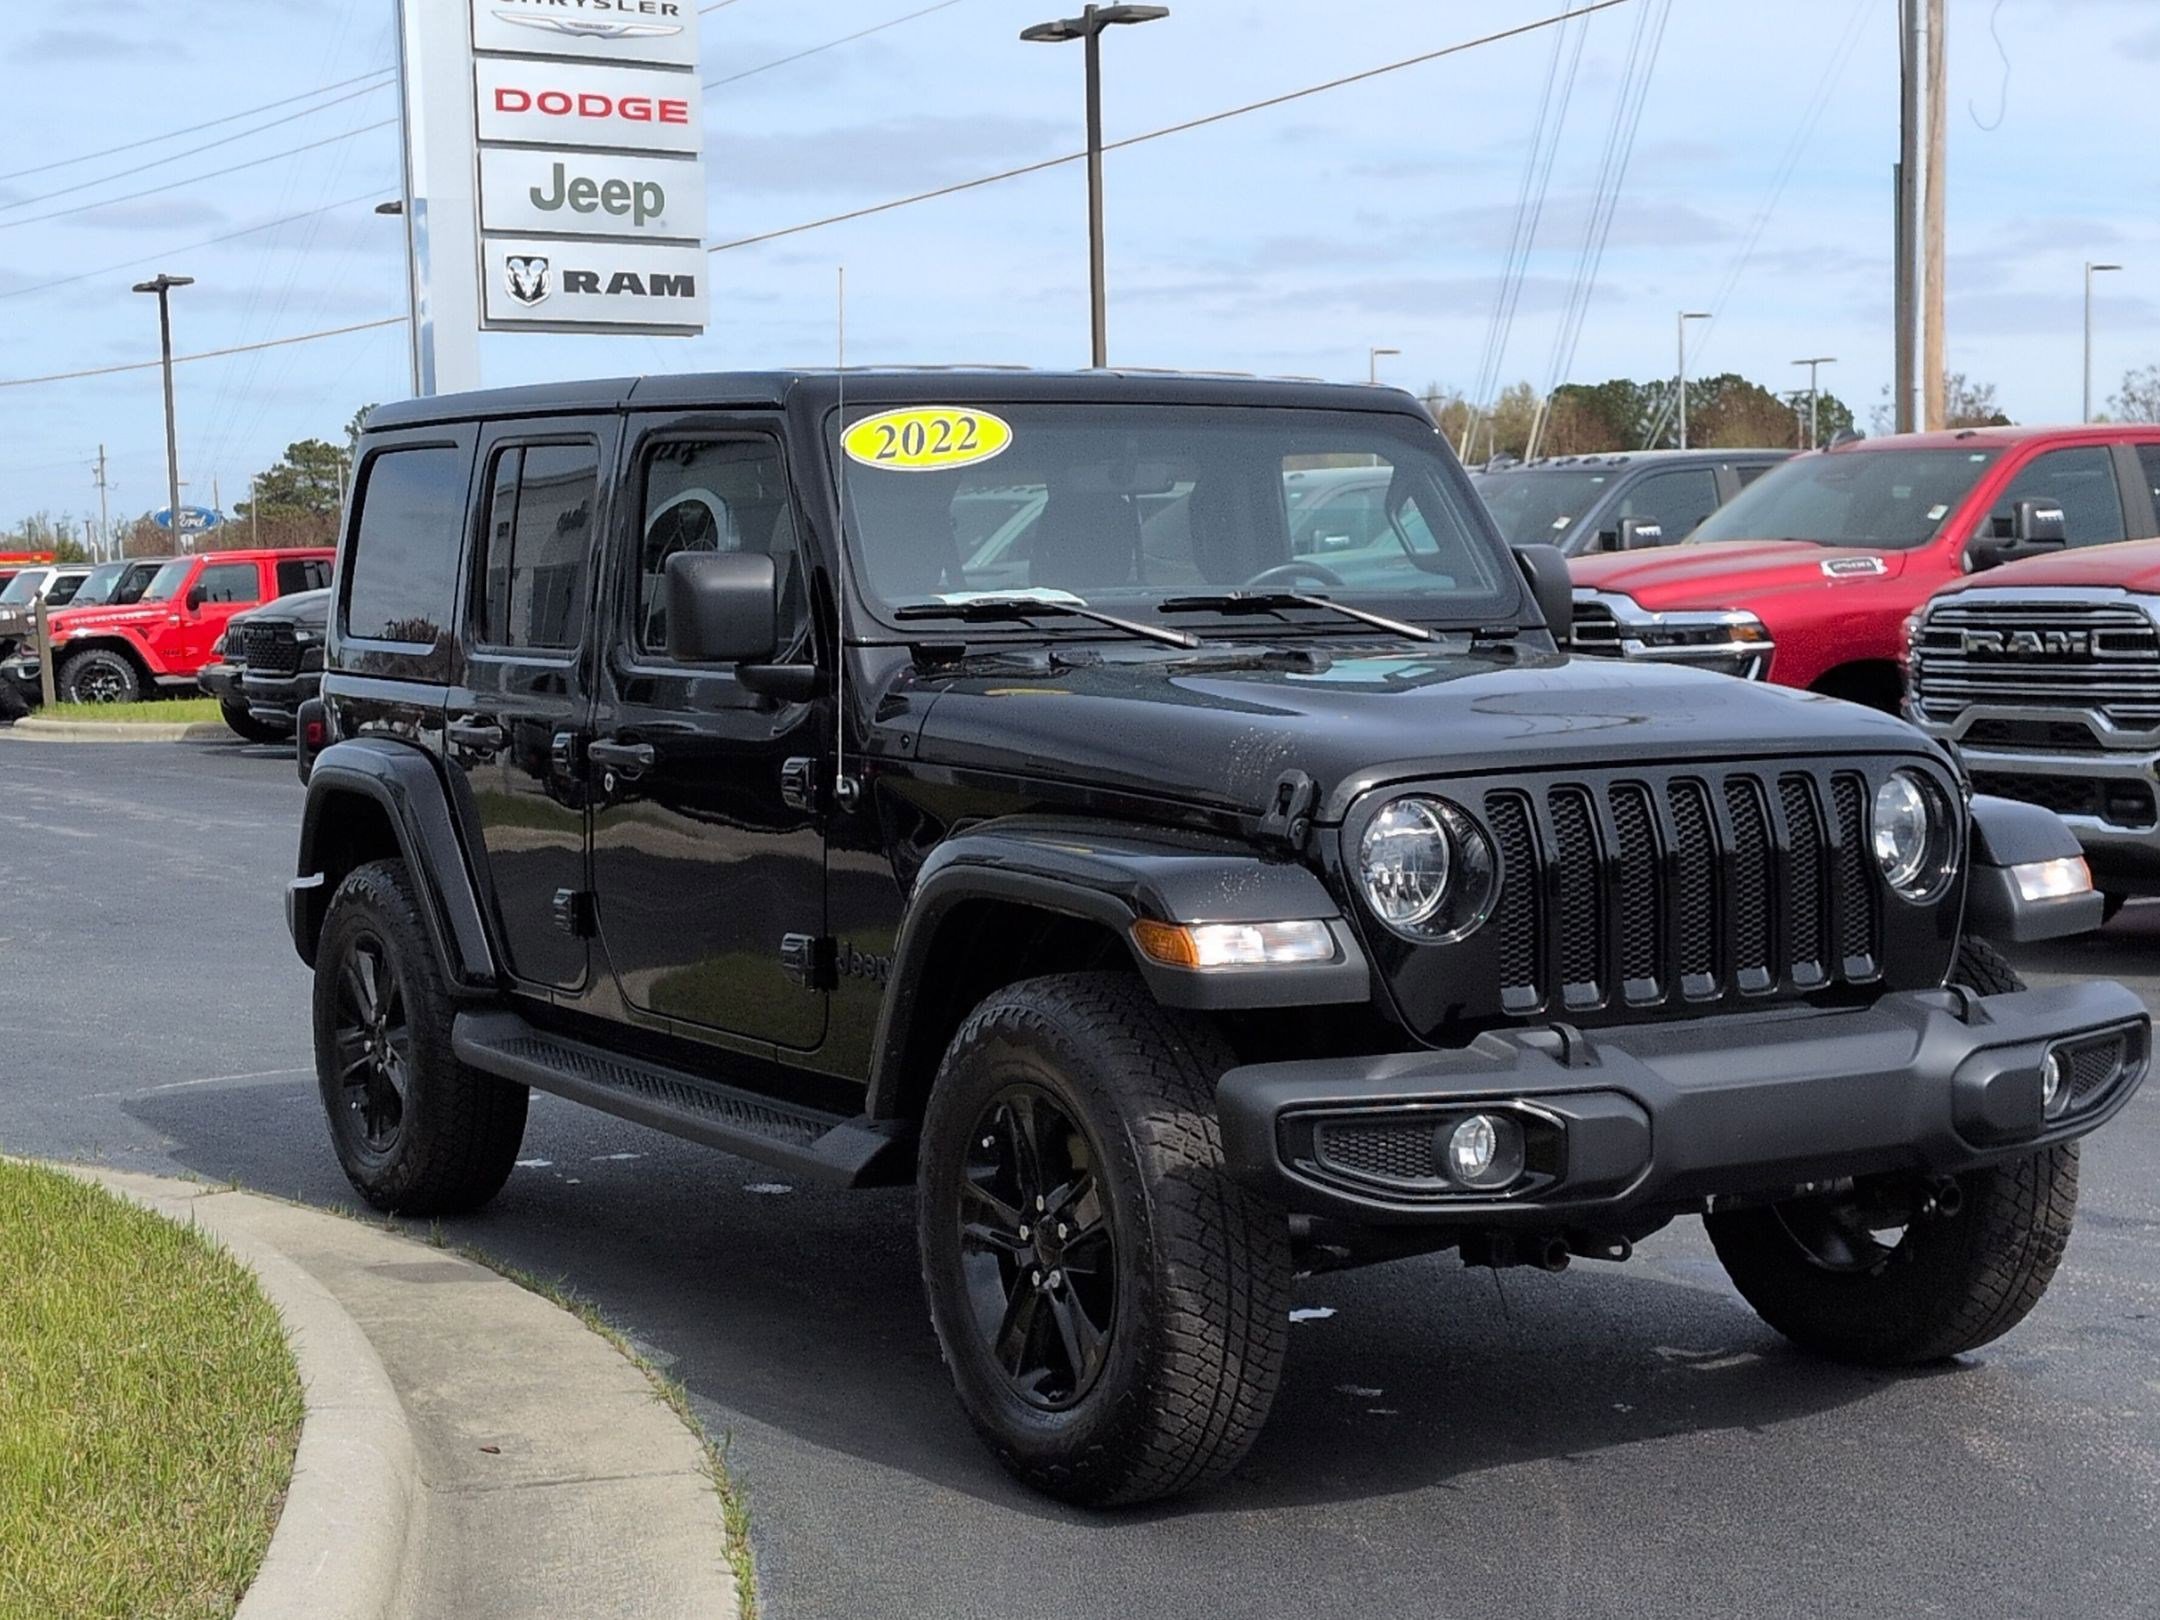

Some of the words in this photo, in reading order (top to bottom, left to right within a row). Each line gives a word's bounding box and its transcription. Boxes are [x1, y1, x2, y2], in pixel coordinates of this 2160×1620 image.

[503, 0, 679, 16] YSLER
[494, 88, 689, 124] DODGE
[529, 162, 665, 226] Jeep
[563, 270, 695, 298] RAM
[875, 416, 979, 460] 2022
[1967, 630, 2088, 653] RAM
